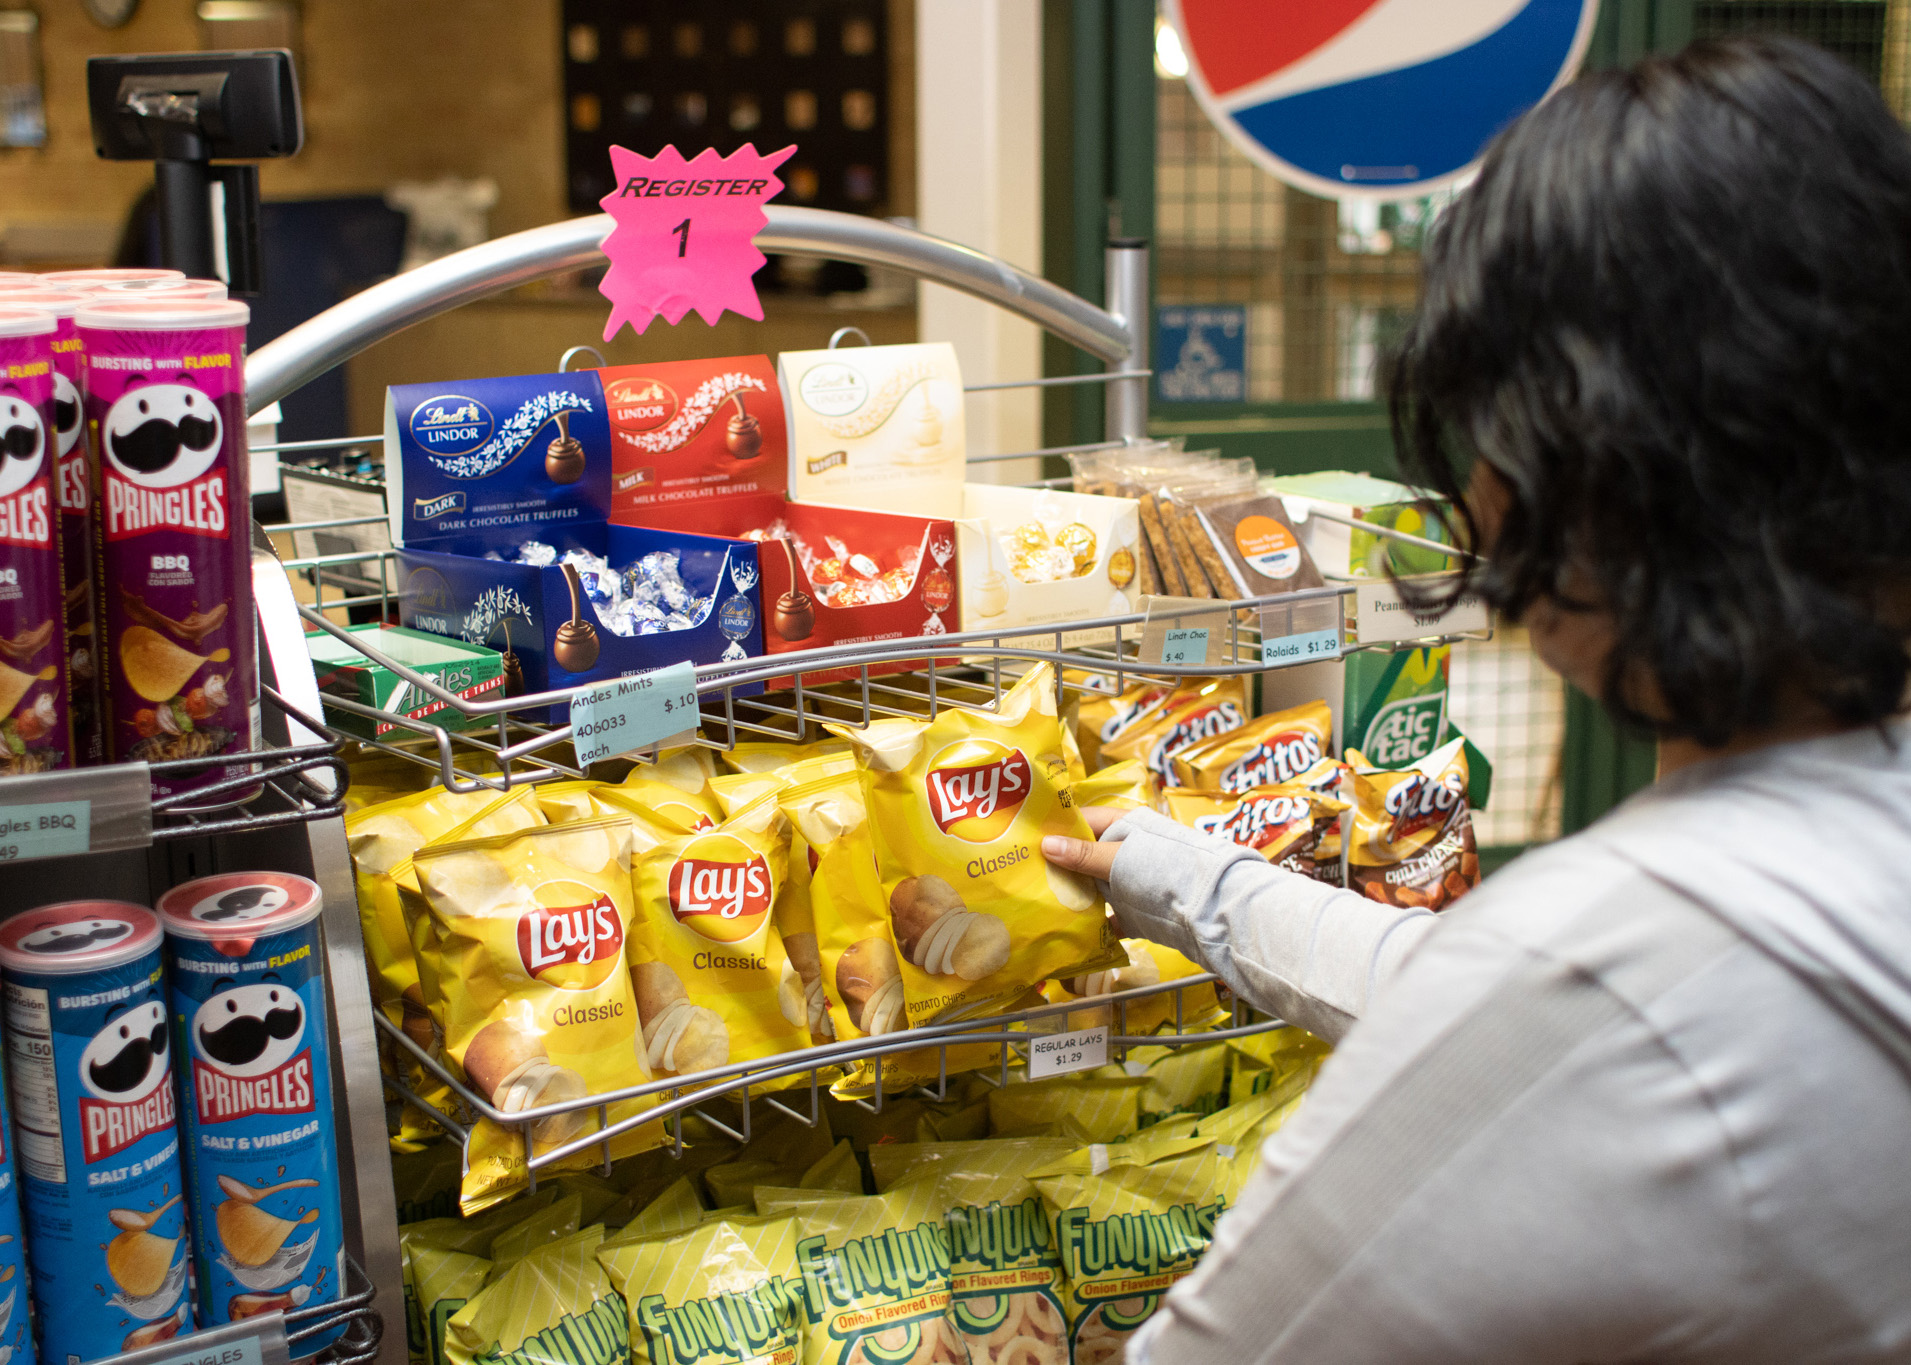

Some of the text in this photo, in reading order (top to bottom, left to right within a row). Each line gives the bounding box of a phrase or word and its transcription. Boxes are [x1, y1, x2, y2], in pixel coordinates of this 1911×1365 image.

[619, 177, 768, 198] REGISTER
[672, 218, 692, 258] 1
[92, 353, 232, 370] BURSTING WITH FLAVOR
[423, 405, 469, 425] Lindt
[617, 405, 664, 420] LINDOR
[427, 427, 479, 443] LINDOR
[809, 454, 842, 474] WHITE
[619, 471, 645, 489] MILK
[633, 482, 758, 505] MILK CHOCOLATE TRUFFLES
[107, 477, 226, 534] PRINGLES
[423, 496, 457, 518] DARK
[516, 499, 547, 510] SMOOTH
[439, 508, 579, 531] DARK CHOCOLATE TRUFFLES
[152, 555, 190, 571] BBQ
[925, 591, 949, 600] LINDOR
[415, 614, 448, 635] LINDOR
[724, 616, 749, 627] LINDOR
[874, 632, 903, 641] SMOOTH
[1168, 630, 1207, 641] Lindt Choc
[1165, 651, 1185, 663] $.40
[1266, 639, 1337, 659] Rolaids $1.29
[417, 676, 502, 718] DE THINS
[572, 677, 653, 710] Andes Mints
[664, 692, 695, 713] $.10
[577, 714, 627, 738] 406033
[1392, 706, 1437, 739] tic
[581, 744, 610, 762] each
[1377, 734, 1431, 765] tac
[1220, 731, 1322, 793] Fritos
[931, 757, 1023, 823] Lay's
[40, 814, 76, 830] BBQ
[1195, 797, 1311, 842] Fritos
[966, 844, 1030, 879] Classic
[1385, 863, 1418, 885] CHILI
[678, 858, 766, 919] Lay's
[526, 898, 615, 970] Lay's
[178, 944, 311, 974] BURSTING WITH FLAVOR
[692, 952, 768, 971] Classic
[59, 978, 151, 1010] BURSTING WITH
[909, 991, 966, 1014] POTATO CHIPS
[552, 998, 624, 1027] Classic
[27, 1041, 51, 1057] 150
[1034, 1034, 1103, 1054] REGULAR LAYS
[882, 1063, 899, 1075] HIPS
[1056, 1052, 1082, 1066] $1.29
[200, 1058, 311, 1118] PRINGLES
[660, 1088, 684, 1102] CHIS
[201, 1120, 319, 1150] SALT & VINEGAR
[487, 1153, 528, 1170] POTATO CHI
[88, 1167, 129, 1186] SALT
[130, 1163, 142, 1177] &
[970, 1273, 1017, 1288] Flavored
[1019, 1269, 1050, 1284] Rings
[1084, 1283, 1117, 1296] Onion
[1121, 1275, 1169, 1291] Flavored
[638, 1276, 803, 1365] FUNYUNS
[839, 1293, 950, 1329] Onion Flavored Rin
